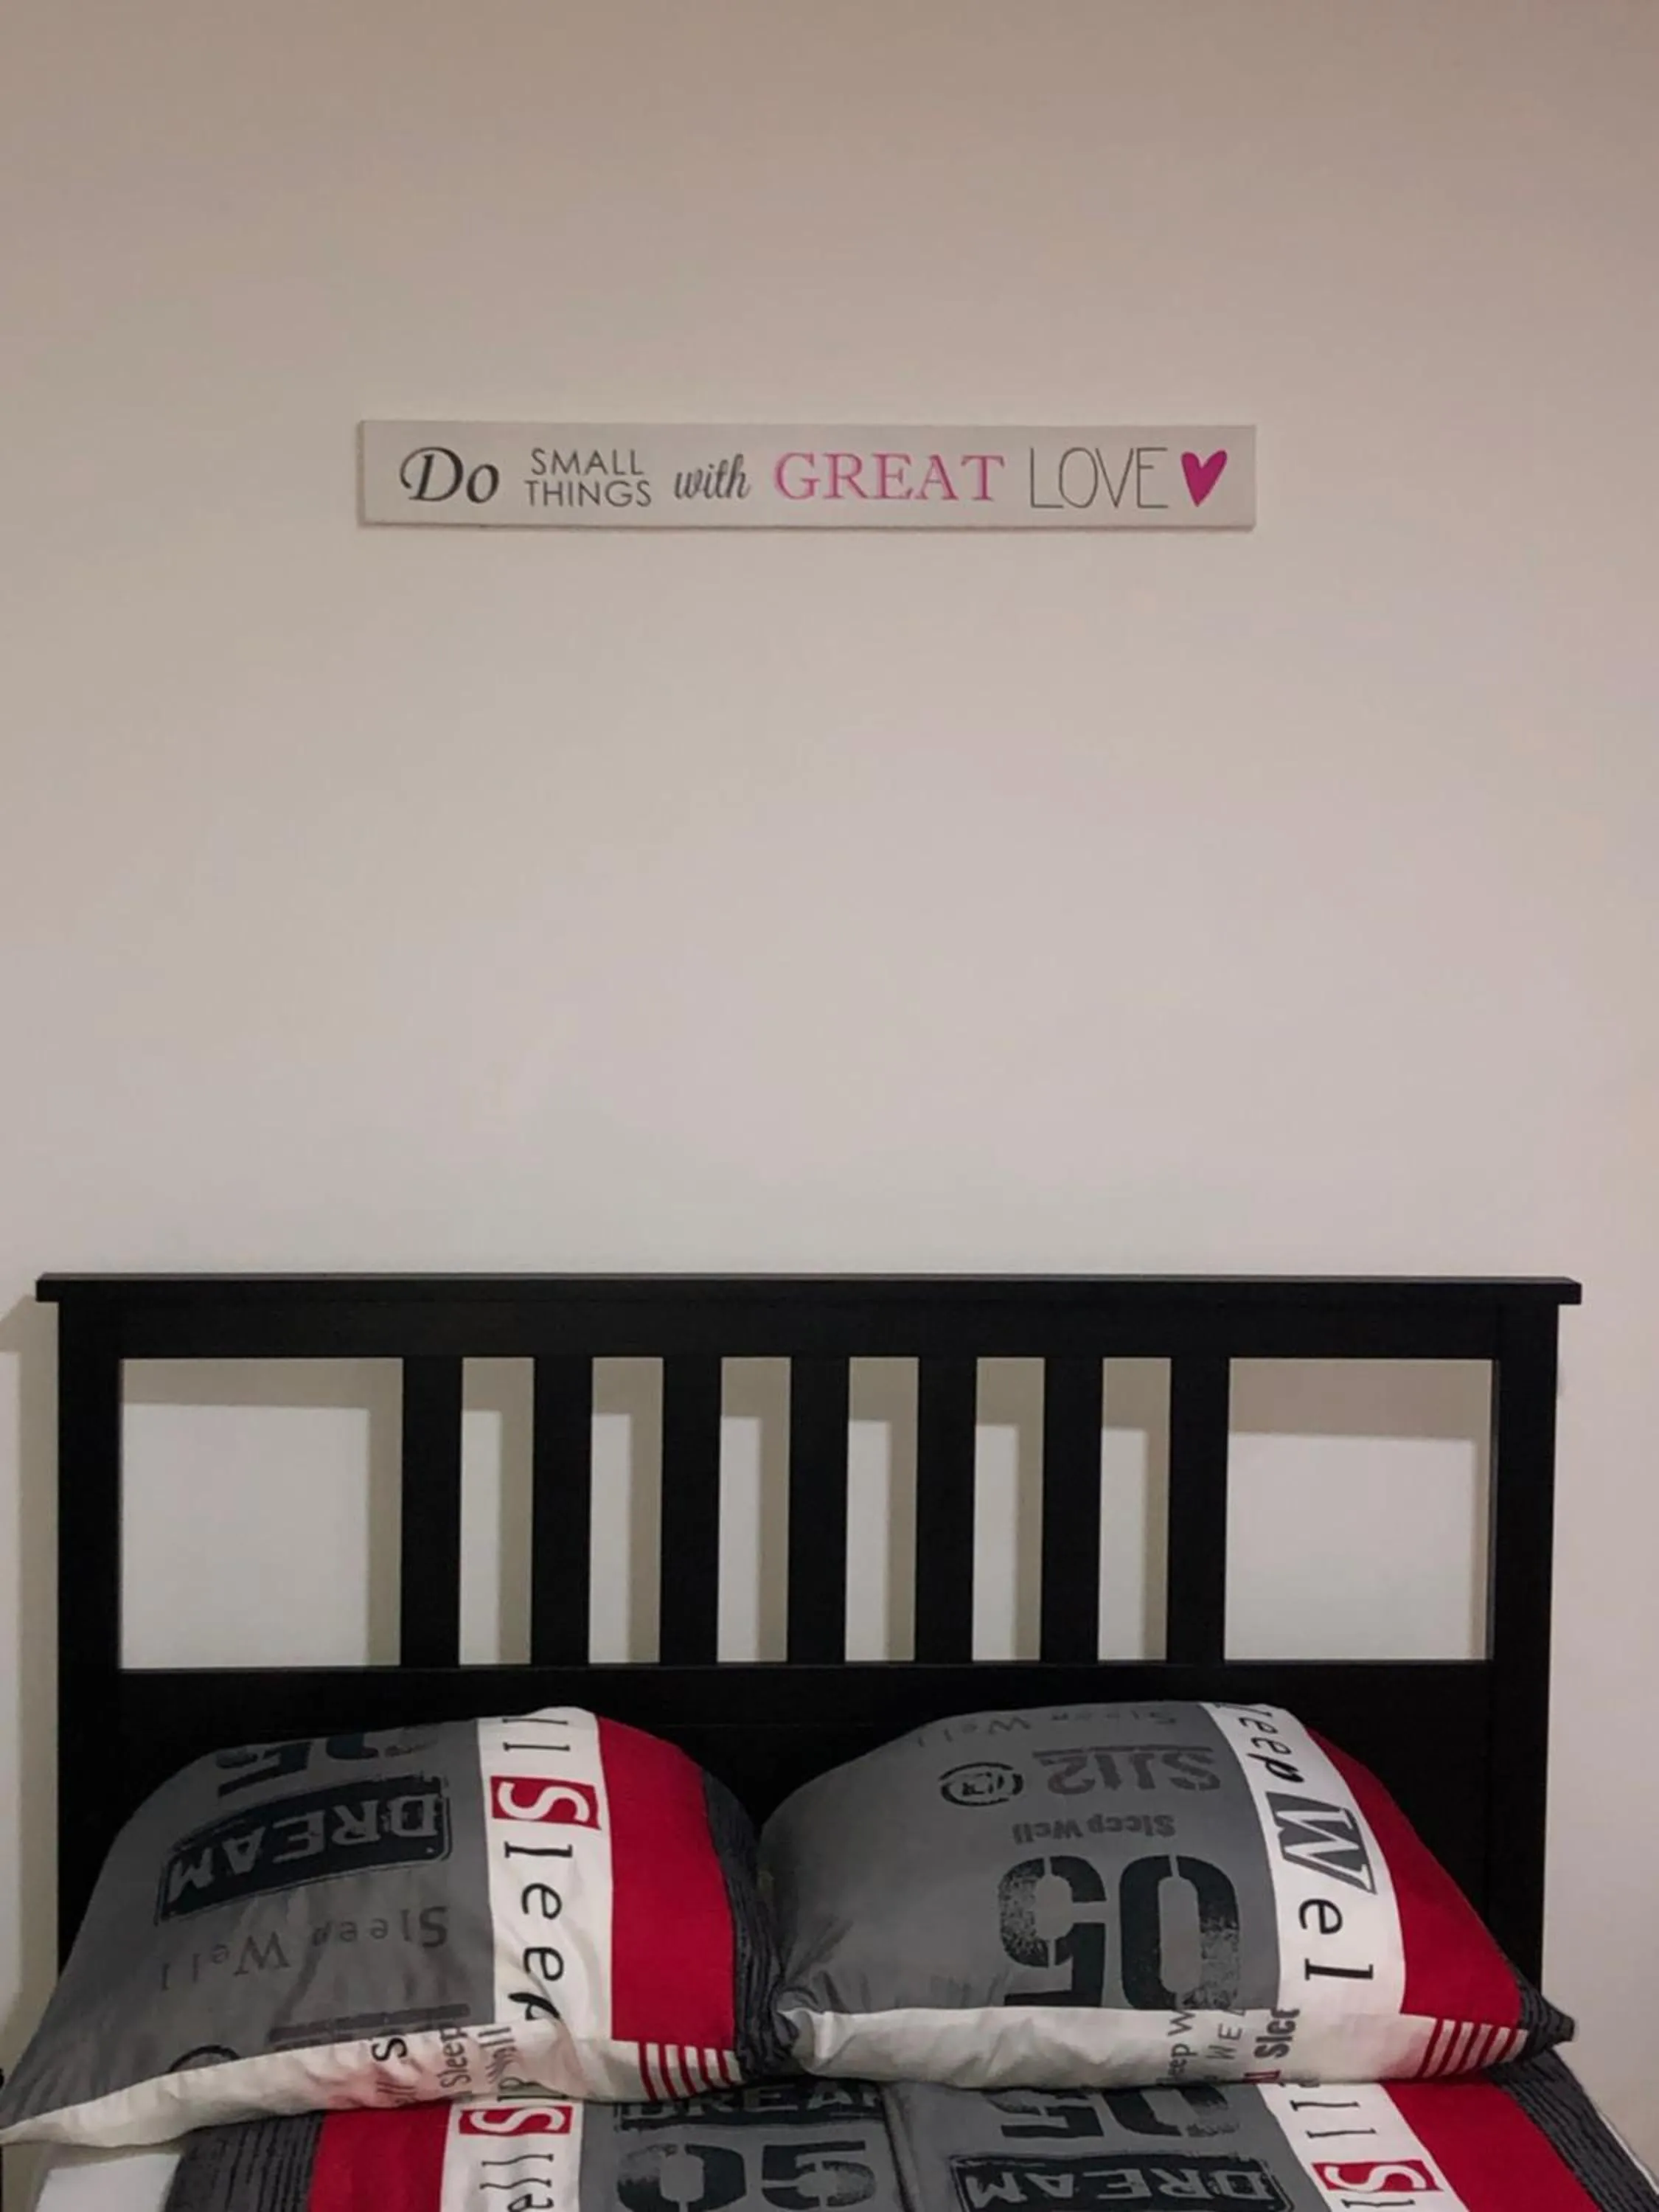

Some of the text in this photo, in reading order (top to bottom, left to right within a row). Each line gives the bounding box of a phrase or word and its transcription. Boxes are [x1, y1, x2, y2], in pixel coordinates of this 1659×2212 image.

[399, 446, 1169, 509] Do SMALL THINGS with GREAT LOVE
[171, 1793, 441, 1904] DREAM
[1012, 1814, 1176, 1845] Sleep Well
[161, 1905, 450, 1991] Sleep Well
[998, 1854, 1239, 2009] 05
[617, 2140, 877, 2211] 05
[963, 2166, 1276, 2210] DREAM
